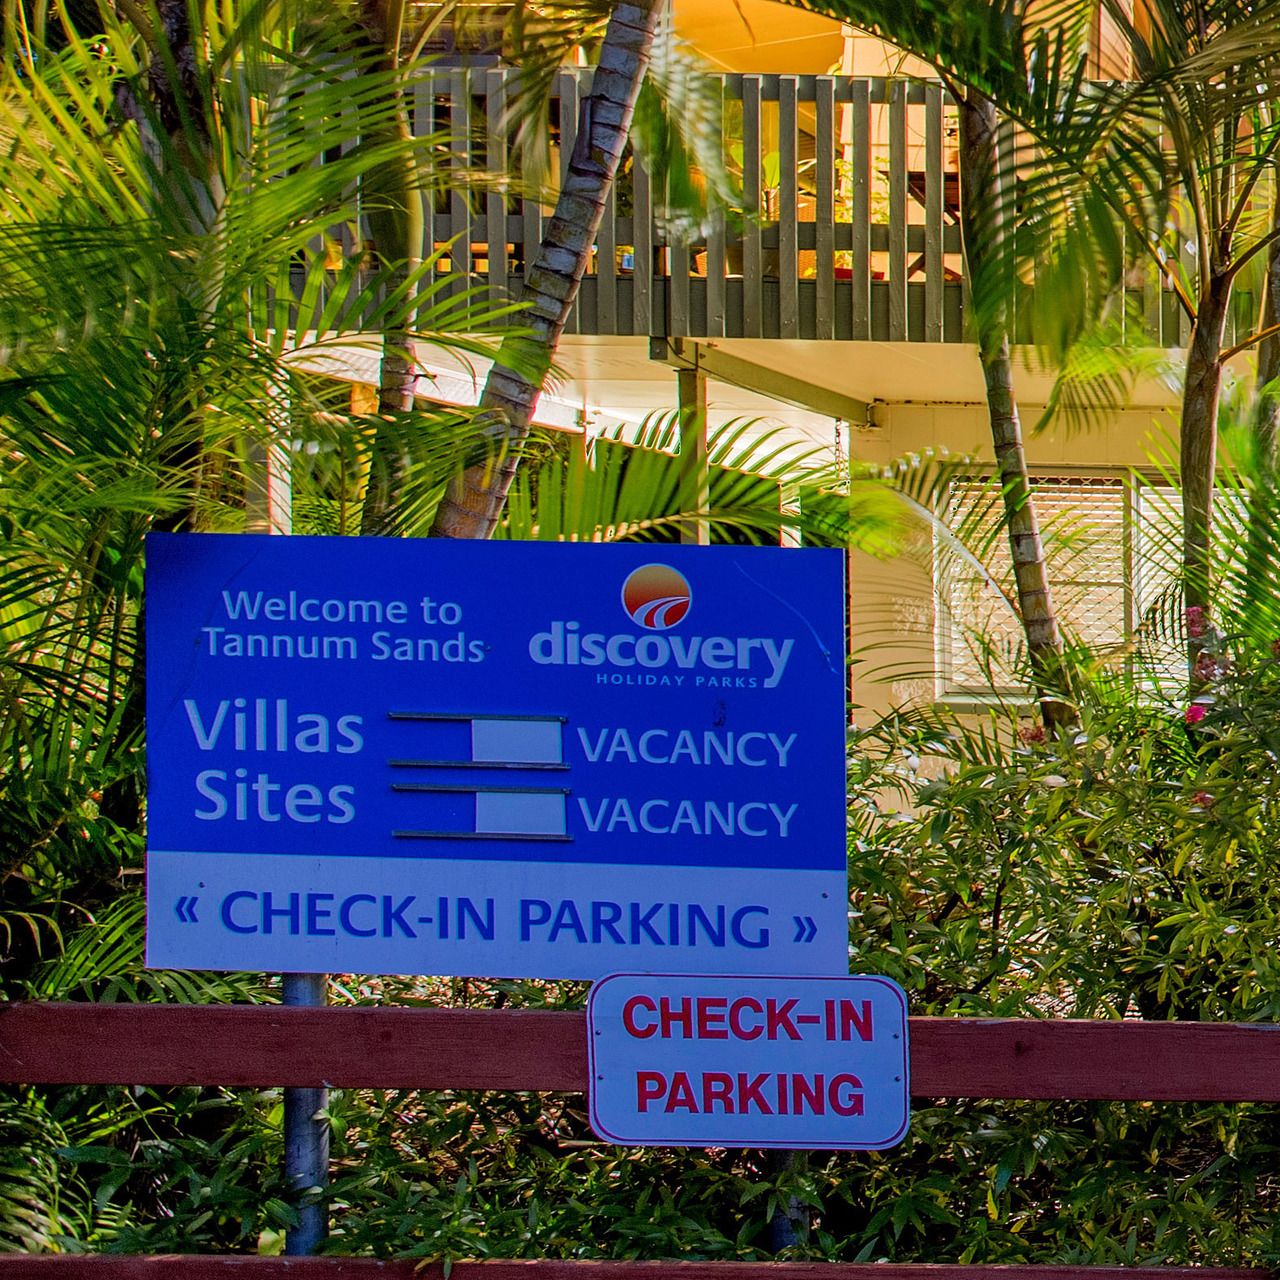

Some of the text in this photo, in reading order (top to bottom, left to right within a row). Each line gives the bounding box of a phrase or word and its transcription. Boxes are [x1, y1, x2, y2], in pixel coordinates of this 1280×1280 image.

[222, 590, 463, 625] Welcome to
[201, 626, 484, 663] Tannum Sands
[528, 621, 795, 688] discovery
[596, 673, 757, 688] HOLIDAY PARKS
[183, 697, 364, 754] Villas
[577, 728, 798, 768] VACANCY
[194, 767, 356, 824] Sites
[577, 797, 799, 838] VACANCY
[221, 890, 770, 949] CHECK-IN PARKING
[622, 994, 874, 1042] CHECK-IN
[635, 1070, 865, 1117] PARKING
